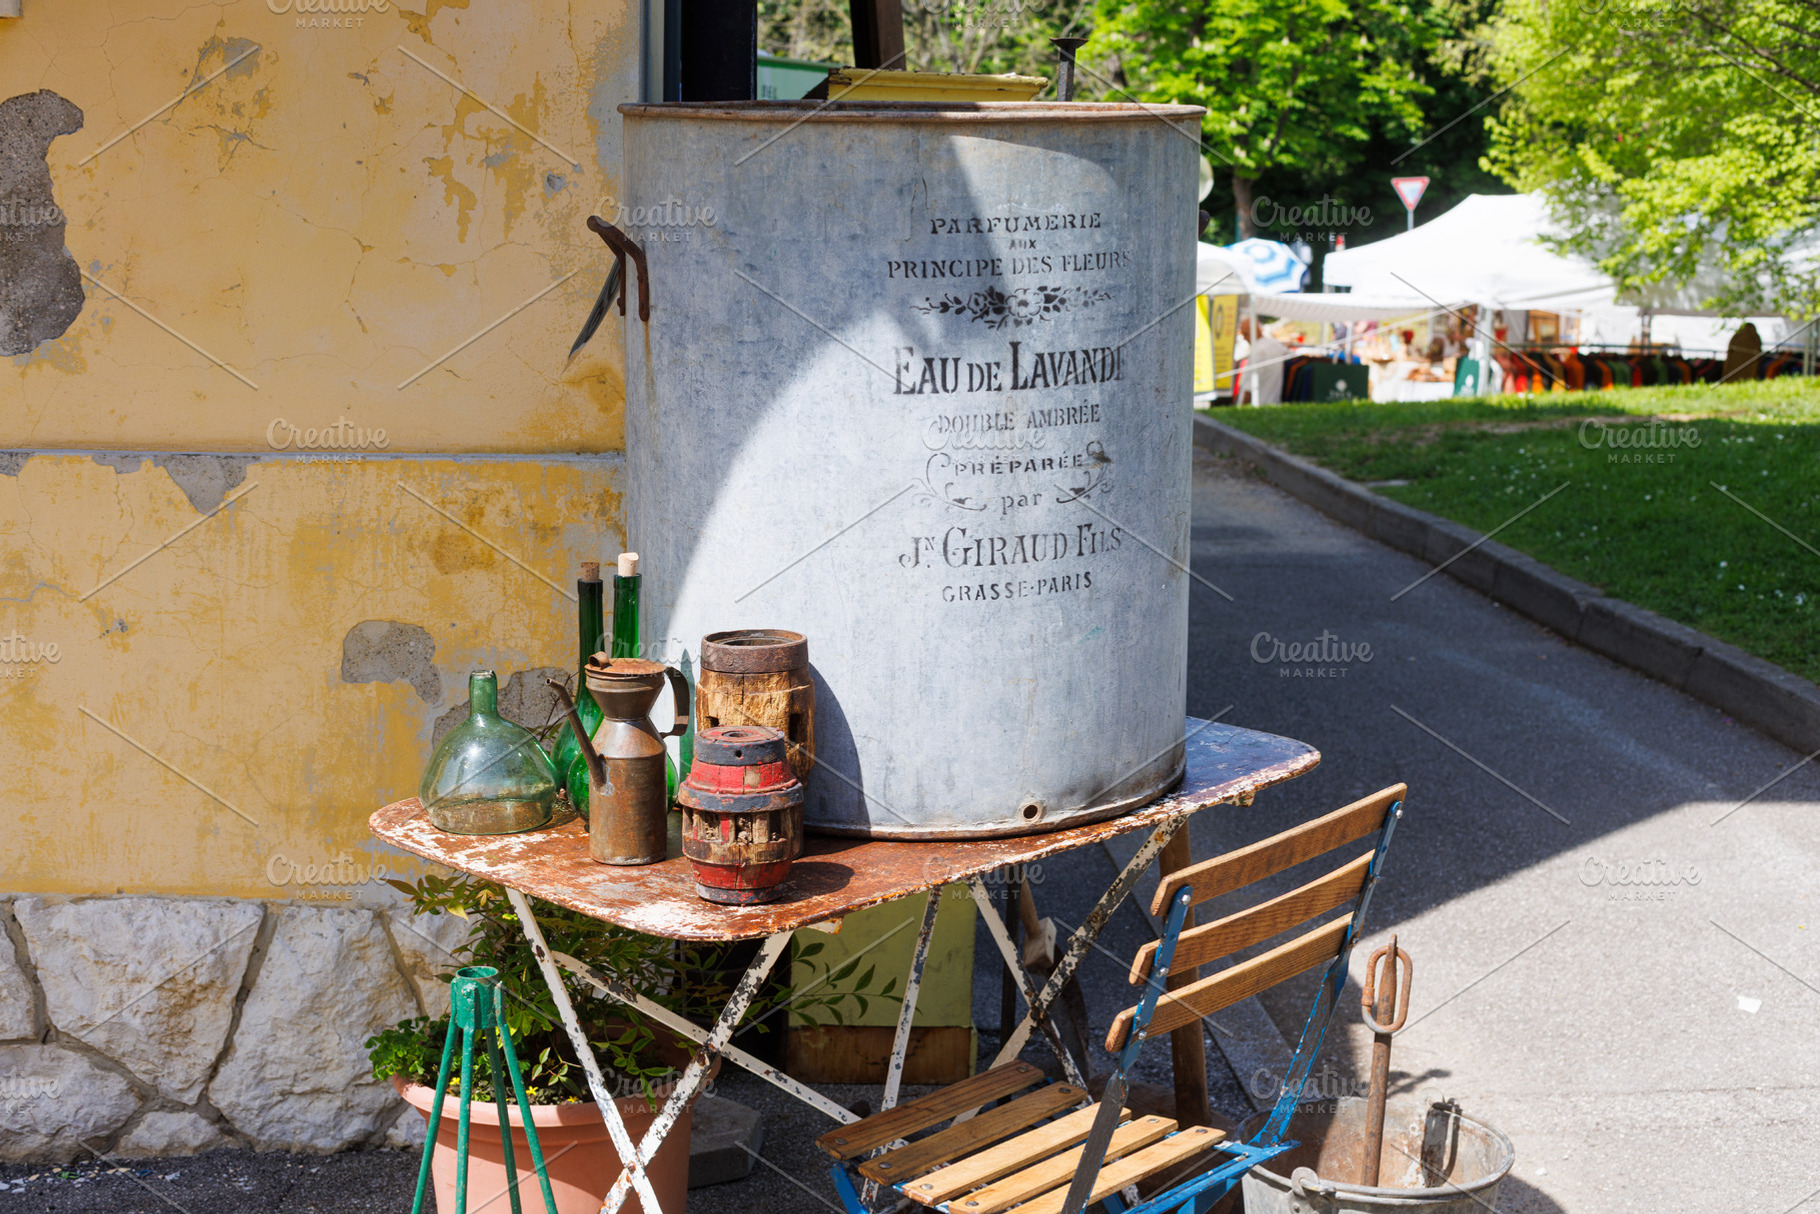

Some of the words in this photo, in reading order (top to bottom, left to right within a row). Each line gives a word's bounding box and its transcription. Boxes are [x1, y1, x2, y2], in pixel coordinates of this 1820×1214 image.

[930, 212, 1101, 235] PARFUMERIE
[1009, 239, 1037, 251] AUX
[887, 257, 1003, 279] PRINCIPE
[1012, 255, 1052, 275] DES
[893, 345, 961, 396] EAU
[967, 362, 1002, 393] DE
[938, 412, 1015, 434] DOUBLE
[1027, 400, 1100, 429] AMBRÉE
[955, 451, 1083, 476] PRÉPARÉE
[1002, 492, 1043, 515] par
[942, 526, 1068, 568] GIRAUD
[1077, 523, 1122, 557] FILS
